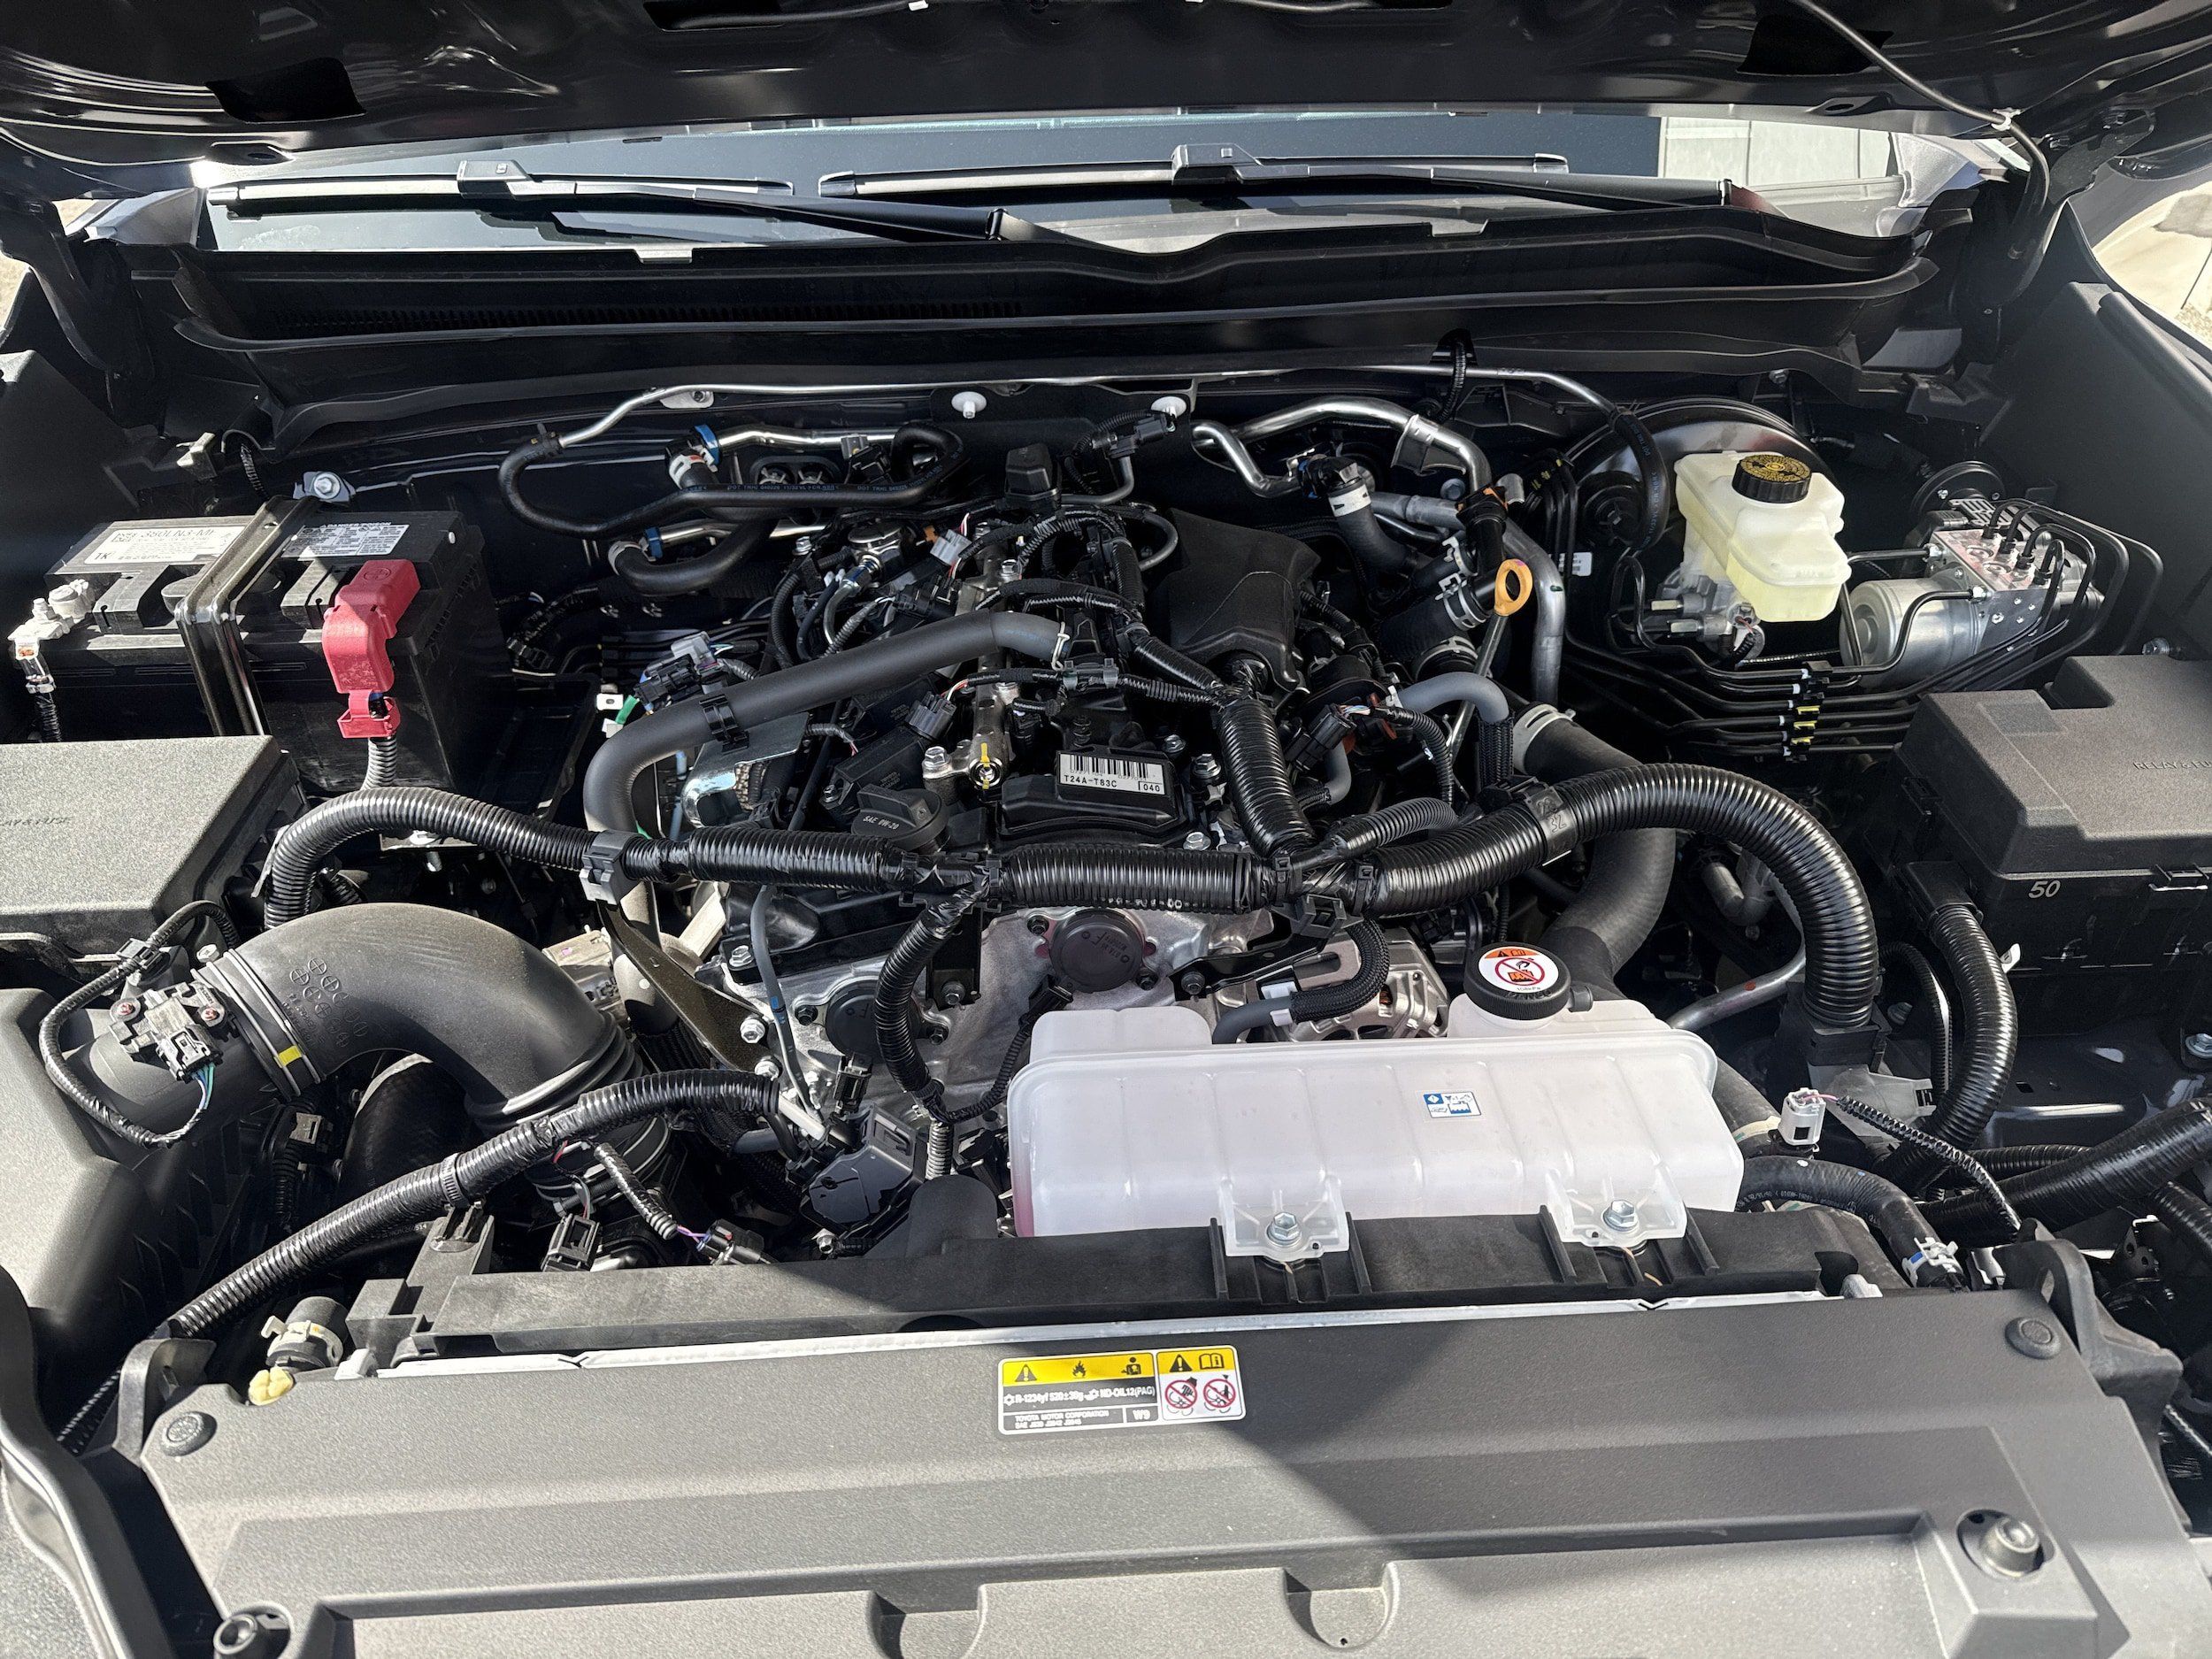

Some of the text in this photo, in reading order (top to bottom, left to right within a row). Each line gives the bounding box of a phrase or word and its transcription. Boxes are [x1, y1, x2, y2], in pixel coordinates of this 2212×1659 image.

[1064, 774, 1118, 788] T24A-T83C
[2028, 879, 2062, 899] 50
[1041, 1412, 1064, 1421] MOTOR
[1064, 1409, 1110, 1419] CORPORATION
